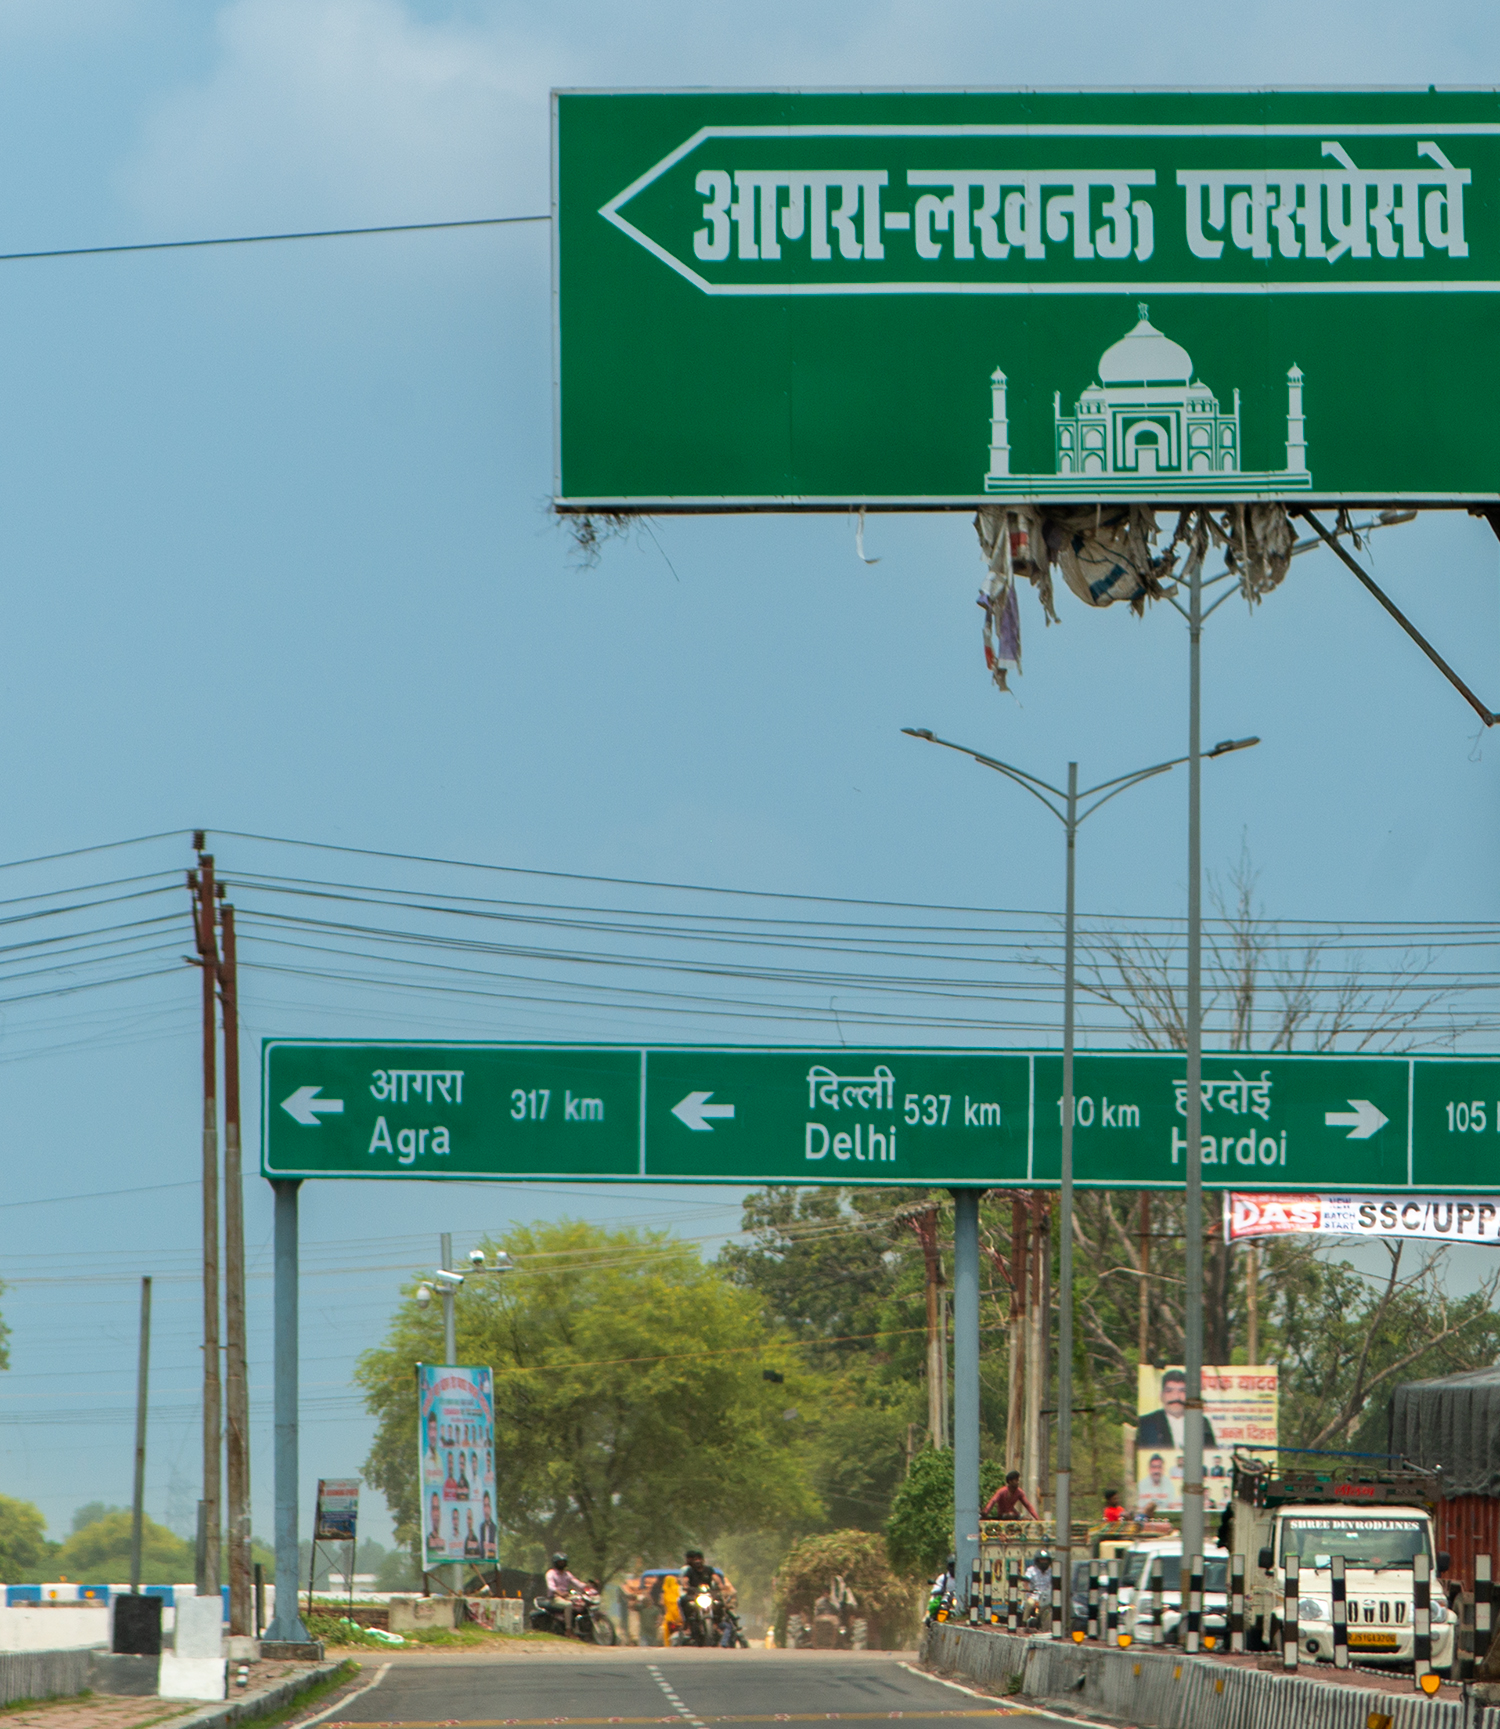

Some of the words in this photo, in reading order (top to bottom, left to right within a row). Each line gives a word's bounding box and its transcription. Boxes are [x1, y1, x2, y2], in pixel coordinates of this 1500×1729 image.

[693, 169, 1156, 262] आगरा-लखनऊ
[1177, 141, 1472, 264] एक्सप्रेसवे
[370, 1069, 464, 1104] आगरा
[806, 1066, 895, 1110] दिल्ली
[1172, 1069, 1273, 1121] हरदोई
[509, 1089, 551, 1121] 317
[563, 1089, 605, 1122] km
[903, 1093, 950, 1126] 537
[963, 1094, 1001, 1127] km
[1102, 1096, 1140, 1127] km
[1446, 1101, 1487, 1133] 105
[368, 1116, 451, 1163] Agra
[806, 1122, 897, 1161] Delhi
[1171, 1126, 1288, 1166] Hardoi
[1233, 1199, 1318, 1230] DAS
[1290, 1519, 1330, 1530] SHREE
